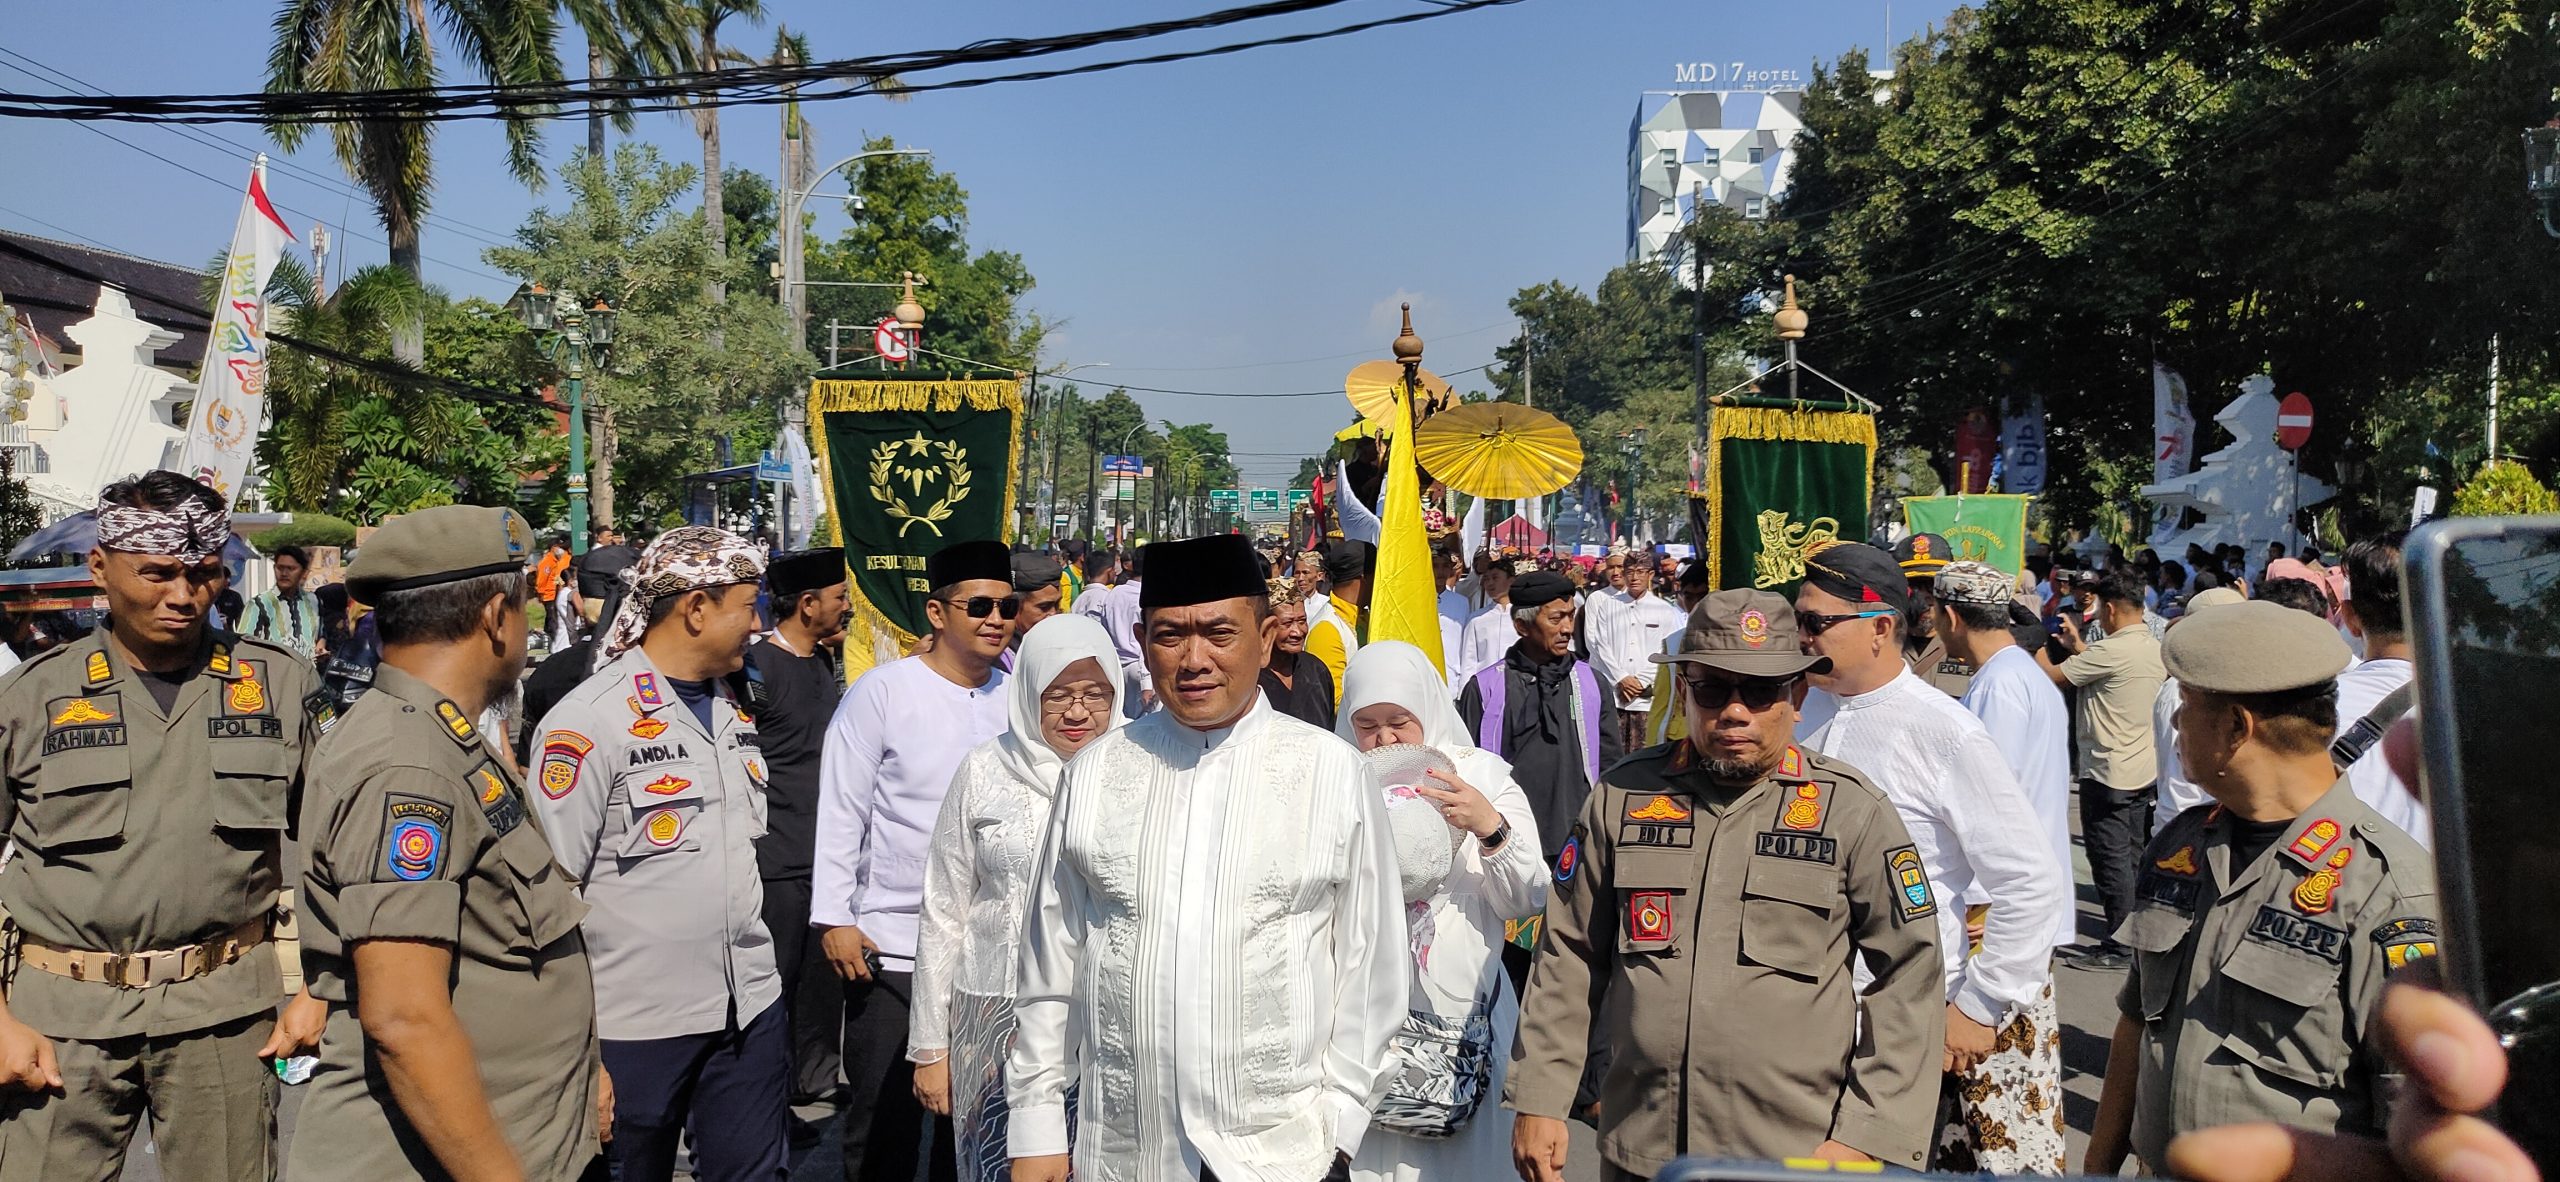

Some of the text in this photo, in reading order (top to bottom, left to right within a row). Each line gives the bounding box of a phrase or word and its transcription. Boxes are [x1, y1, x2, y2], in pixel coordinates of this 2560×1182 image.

[1675, 62, 1799, 82] MD 7 HOTEL
[2016, 424, 2041, 466] bjb
[1940, 664, 1962, 674] POL
[213, 719, 280, 735] POL PP
[45, 727, 120, 751] RAHMAT
[1637, 826, 1676, 844] EDI S
[1760, 834, 1834, 860] POL PP
